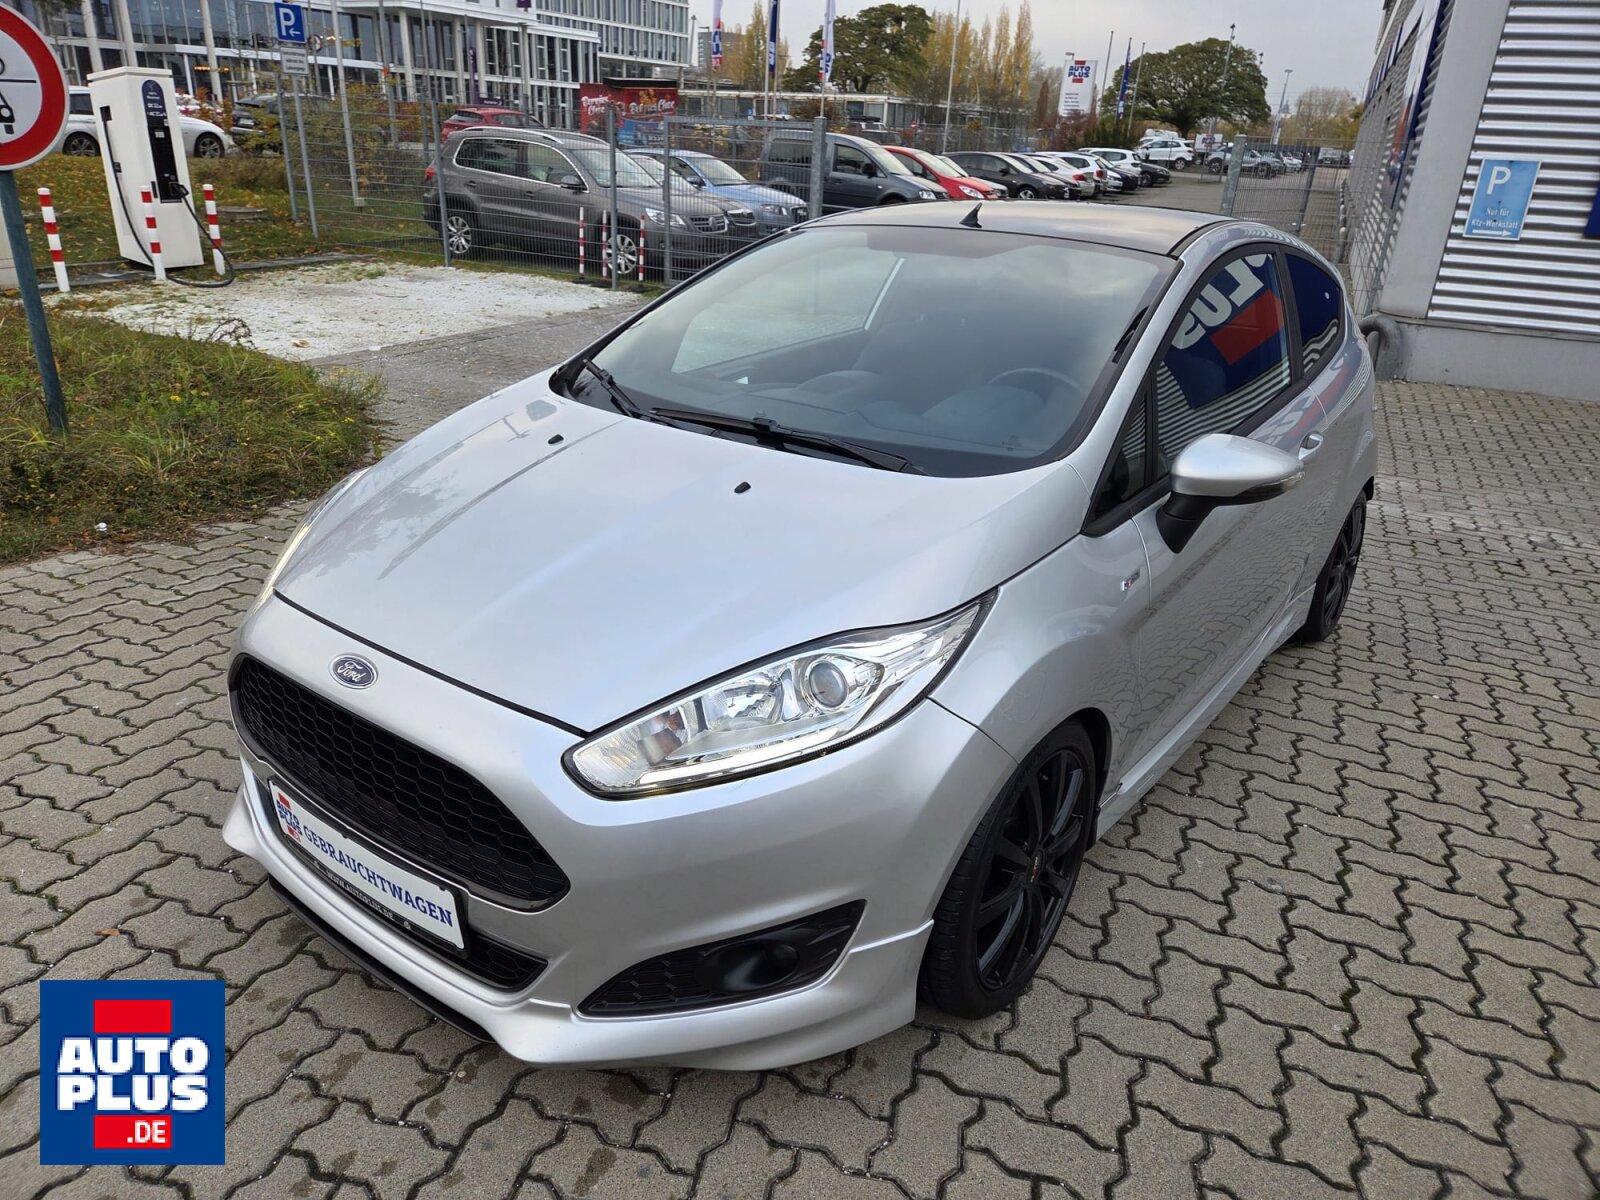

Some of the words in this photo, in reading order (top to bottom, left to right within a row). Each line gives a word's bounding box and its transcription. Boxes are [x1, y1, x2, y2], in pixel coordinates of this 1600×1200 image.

[279, 8, 295, 36] P
[1486, 166, 1511, 195] P
[1471, 219, 1519, 229] Kfz-Werkstatt
[1486, 208, 1498, 216] Nur
[1499, 208, 1510, 217] für
[337, 660, 367, 682] Ford
[303, 825, 454, 928] GEBRAUCHTWAGEN
